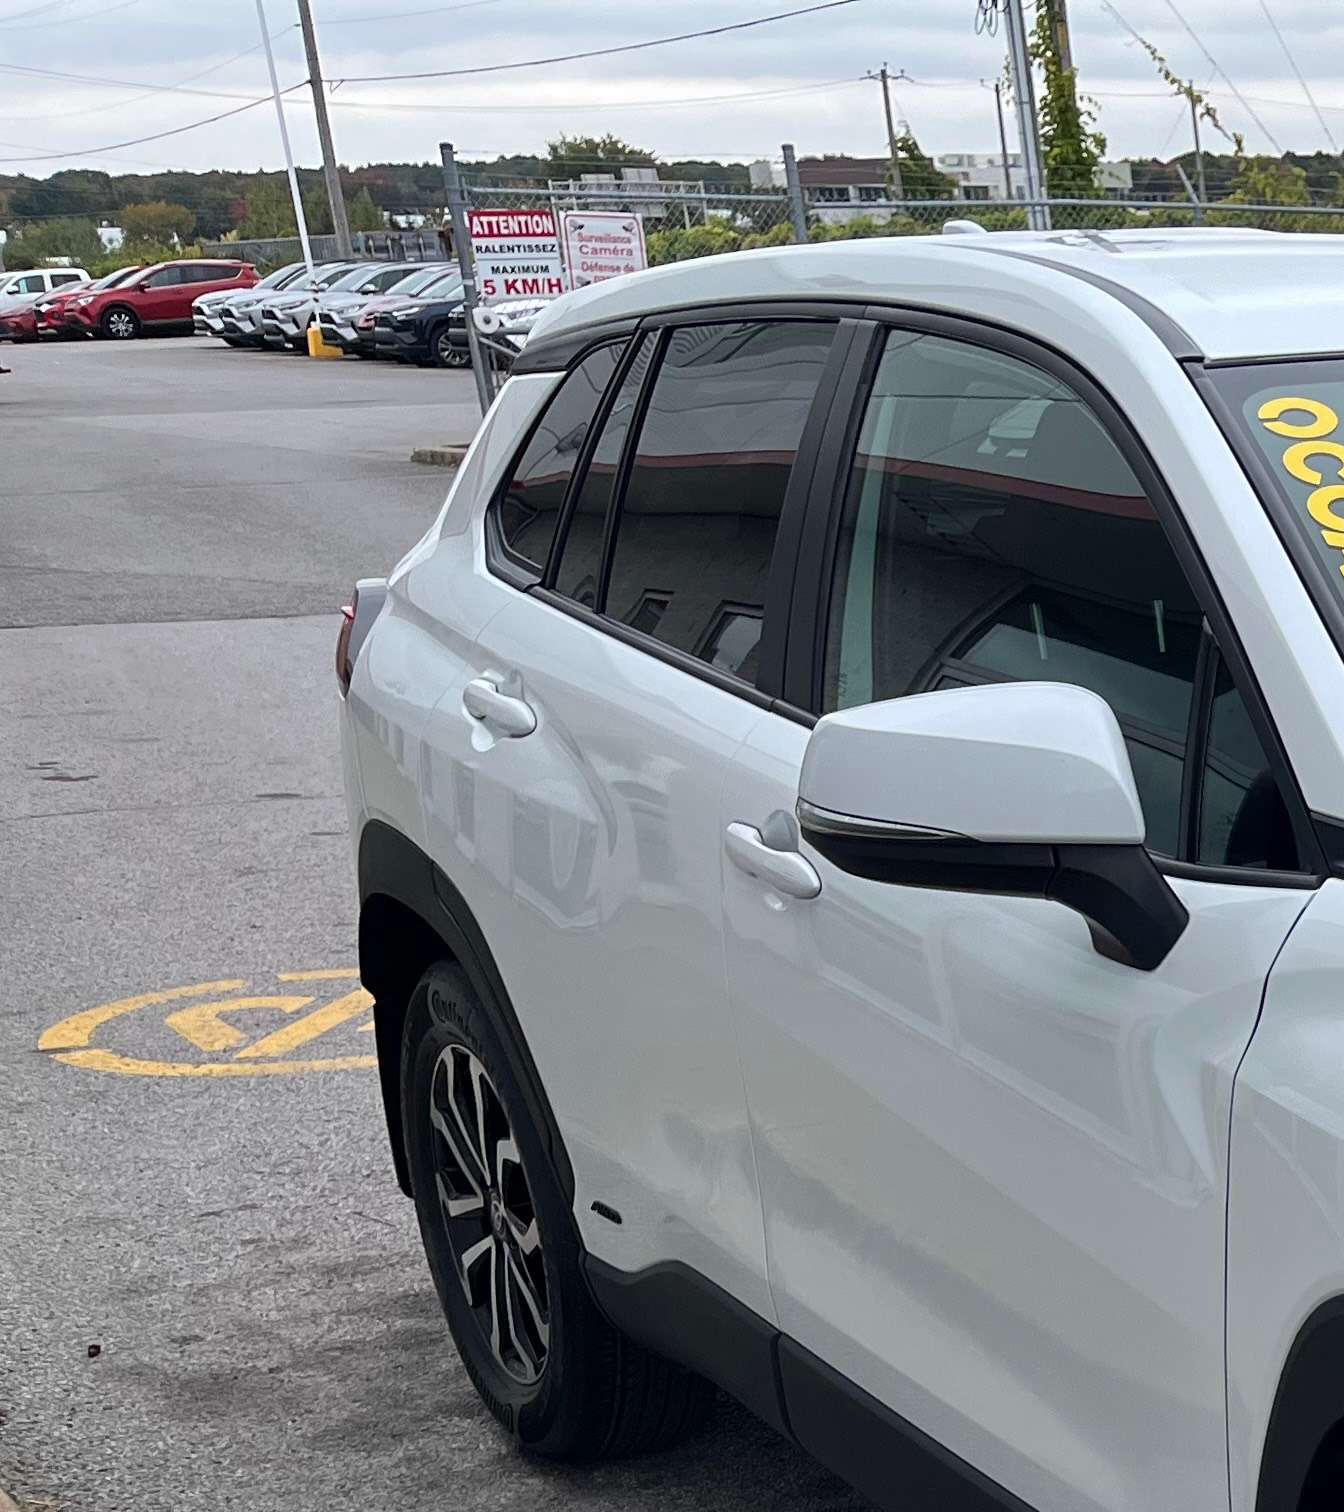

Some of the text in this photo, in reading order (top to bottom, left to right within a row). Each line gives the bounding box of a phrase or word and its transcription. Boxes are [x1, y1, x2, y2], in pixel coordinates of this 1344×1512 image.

[472, 215, 554, 235] ATTENTION
[476, 244, 557, 254] RALENTISSEZ
[579, 245, 633, 256] Caméra
[491, 265, 550, 274] MAXIMUM
[581, 261, 622, 272] Défense
[483, 278, 563, 295] 5 KM/H
